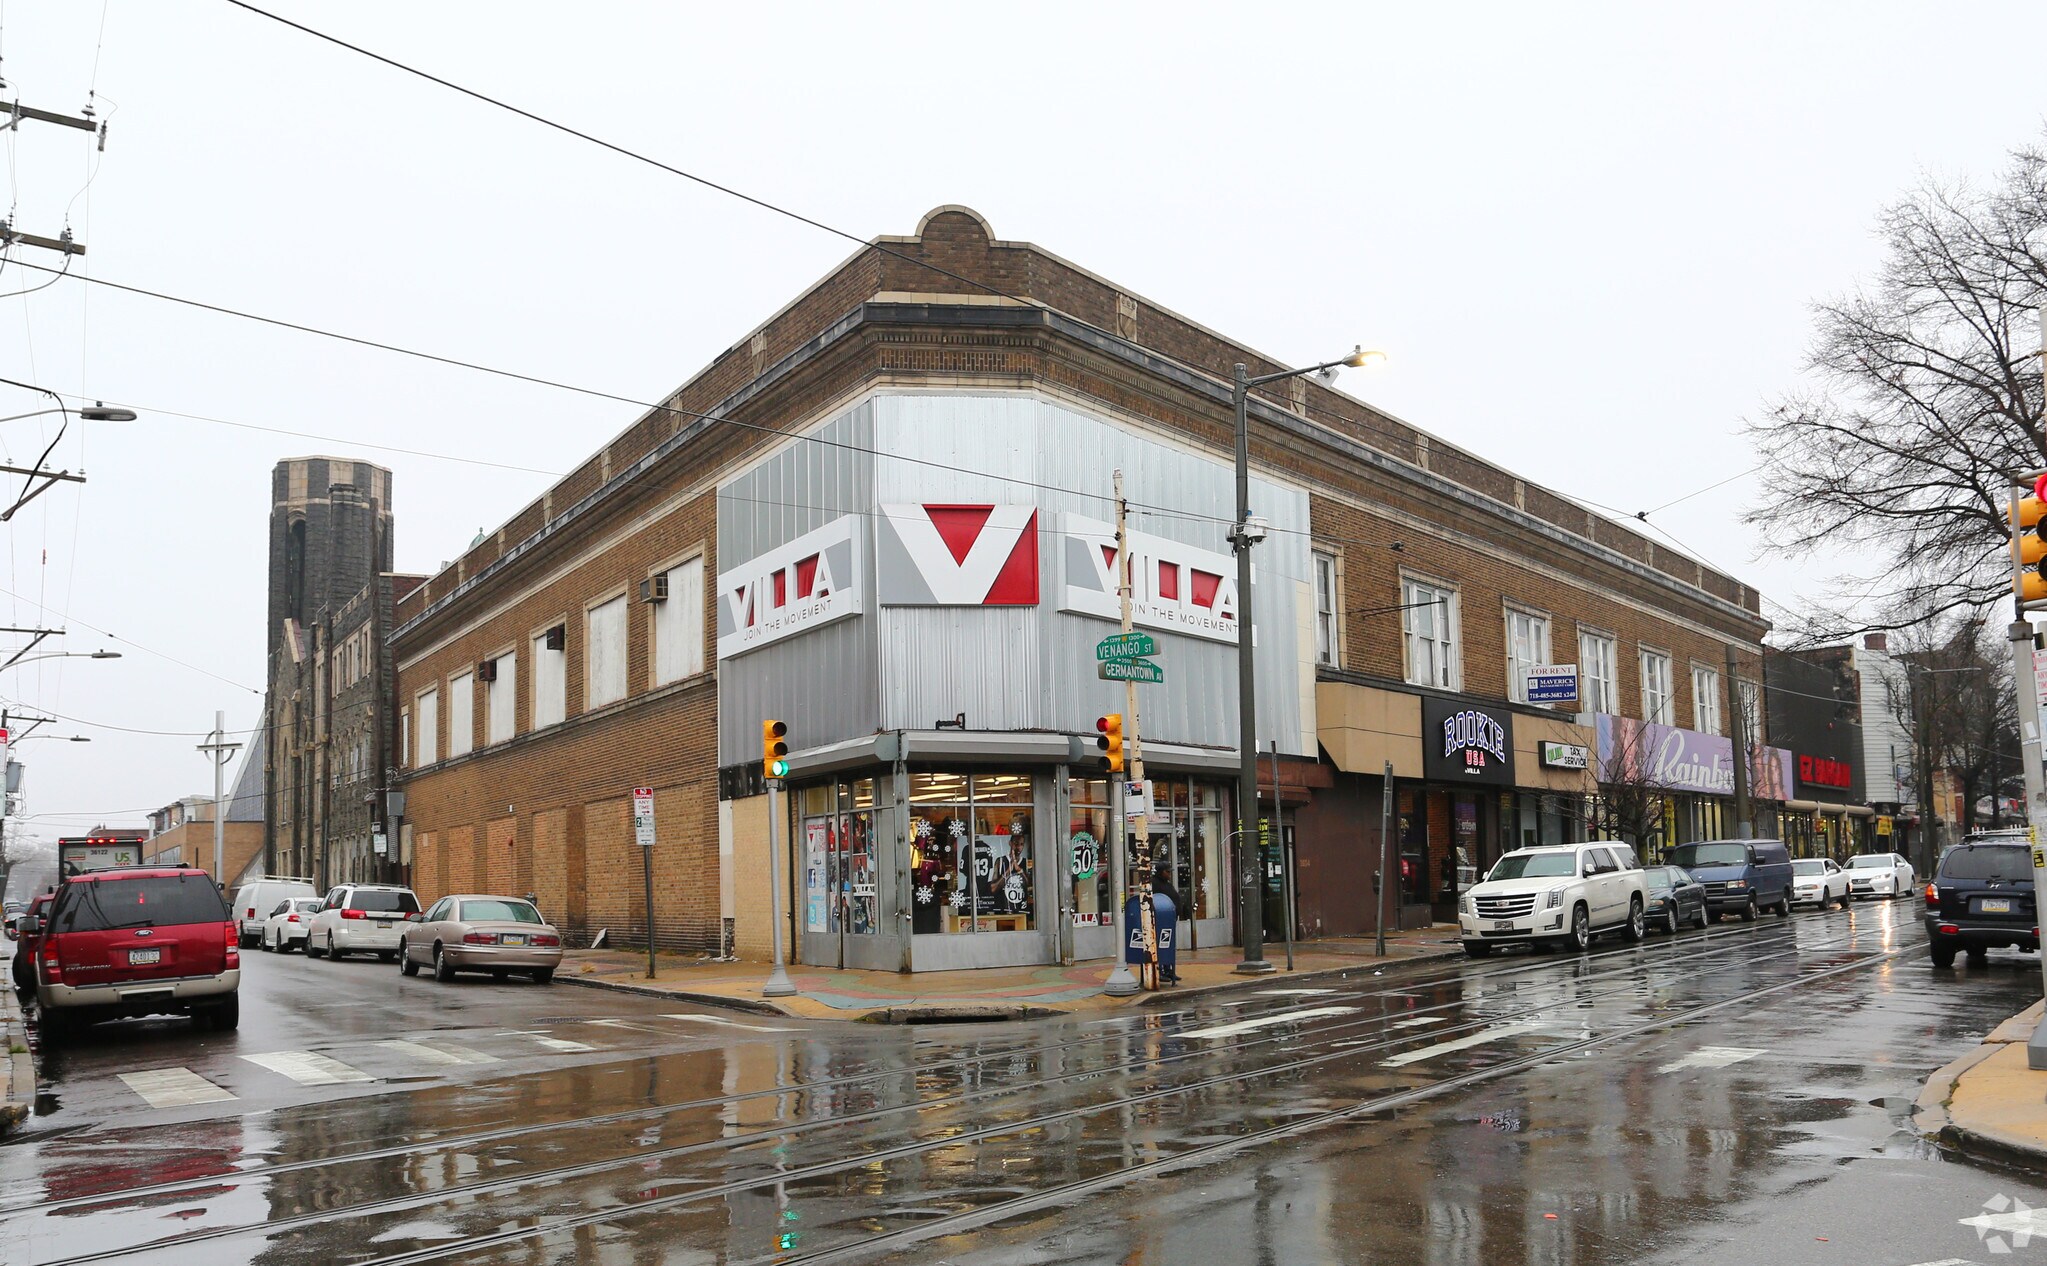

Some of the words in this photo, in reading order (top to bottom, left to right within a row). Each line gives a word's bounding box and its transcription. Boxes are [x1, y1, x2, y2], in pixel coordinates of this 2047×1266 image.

[727, 549, 836, 634] VILLA
[744, 626, 762, 641] JOIN
[765, 617, 781, 636] THE
[784, 599, 831, 625] MOVEMENT
[1152, 606, 1174, 621] THE
[1180, 613, 1239, 634] MOVEMENT
[1098, 641, 1140, 659] VENANGO
[1144, 643, 1152, 653] ST
[1105, 663, 1155, 681] GERMANTOWN
[1444, 710, 1505, 764] ROOKIE
[1465, 749, 1486, 767] USA
[1570, 747, 1581, 756] TAX
[974, 859, 989, 877] 13
[1073, 849, 1092, 875] 50
